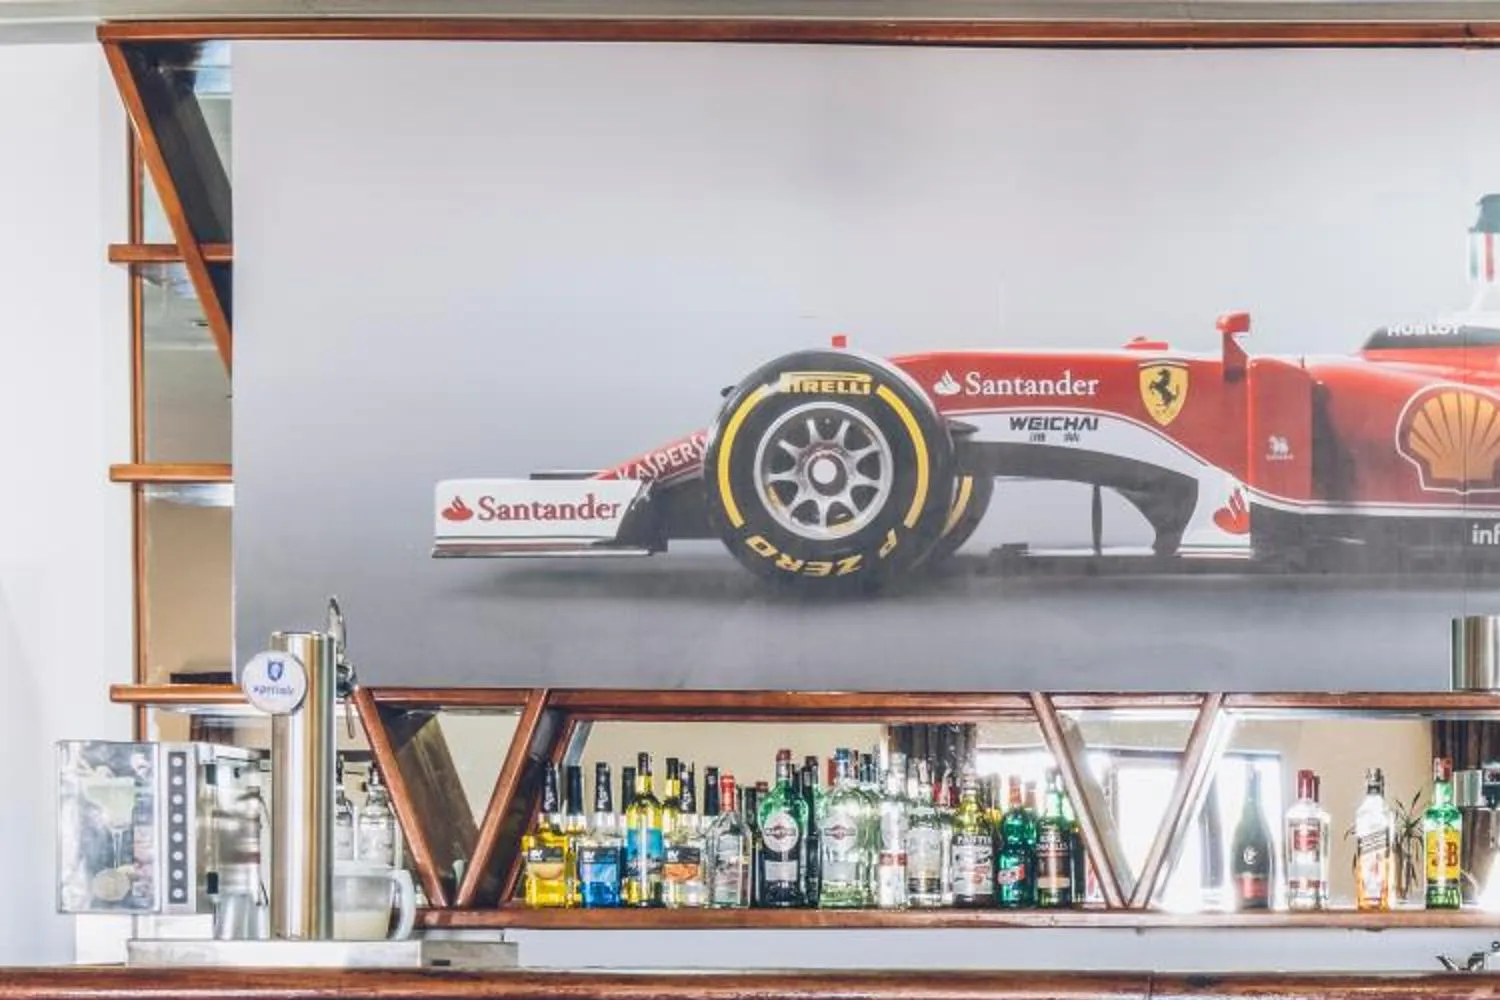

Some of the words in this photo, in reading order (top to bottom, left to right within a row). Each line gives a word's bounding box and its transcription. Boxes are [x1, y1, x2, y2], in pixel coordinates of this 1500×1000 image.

[780, 371, 872, 395] PIRELLI
[965, 369, 1099, 397] Santander
[1009, 416, 1099, 431] WEICHAI
[478, 495, 621, 523] Santander
[745, 535, 863, 577] ZERO
[879, 528, 898, 559] P
